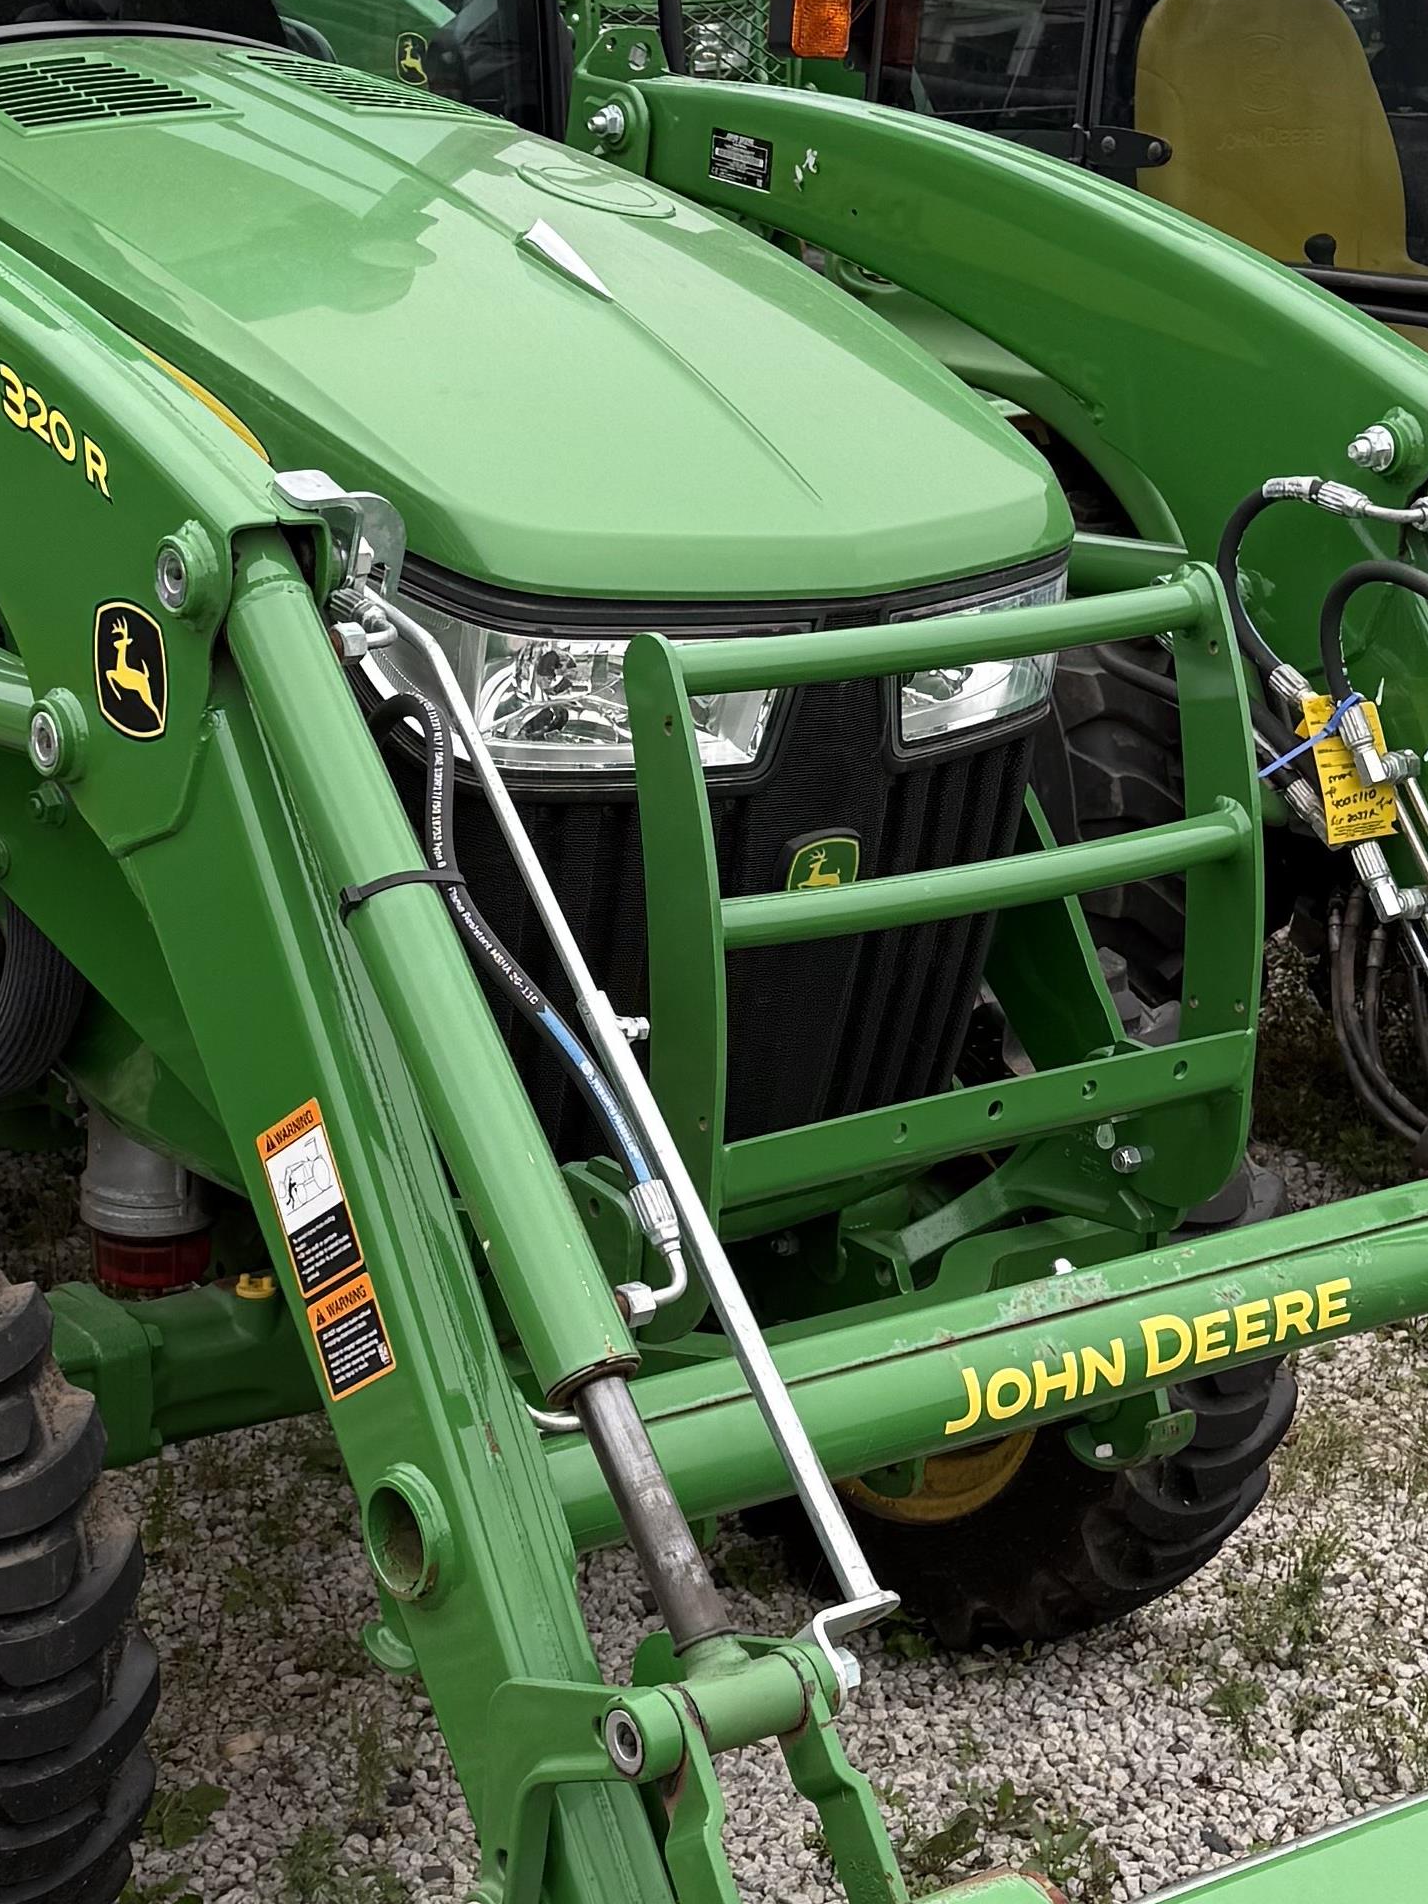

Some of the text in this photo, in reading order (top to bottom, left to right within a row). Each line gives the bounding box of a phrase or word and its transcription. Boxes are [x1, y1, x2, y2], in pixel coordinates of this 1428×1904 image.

[83, 435, 112, 499] R
[273, 1109, 315, 1145] WARNING
[325, 1284, 368, 1318] WARNING
[944, 1277, 1354, 1435] JOHN DEERE
